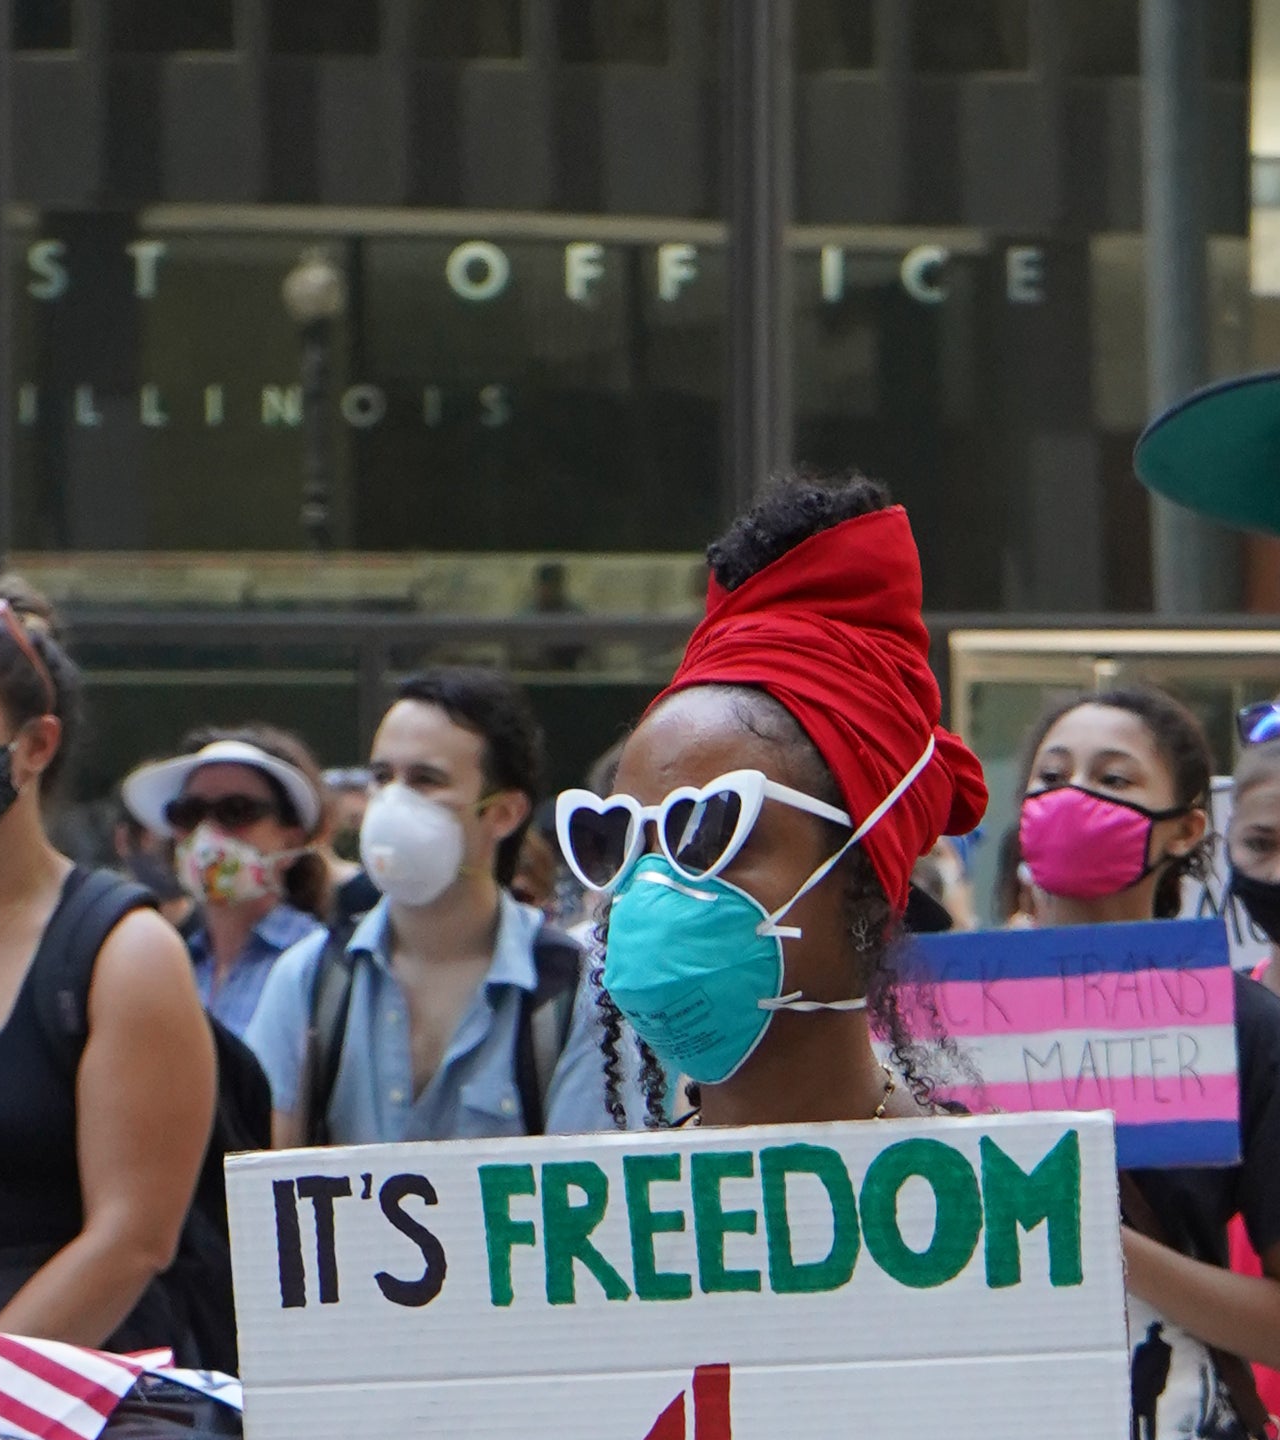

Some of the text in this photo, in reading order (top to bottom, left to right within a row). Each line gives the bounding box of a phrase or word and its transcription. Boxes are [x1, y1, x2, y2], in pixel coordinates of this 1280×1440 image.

[444, 239, 1048, 306] OFFICE
[17, 380, 511, 428] ILLINOIS
[1052, 950, 1210, 1022] TRANS
[1022, 1032, 1207, 1112] MATTER
[272, 1128, 1084, 1309] IT'S FREEDOM
